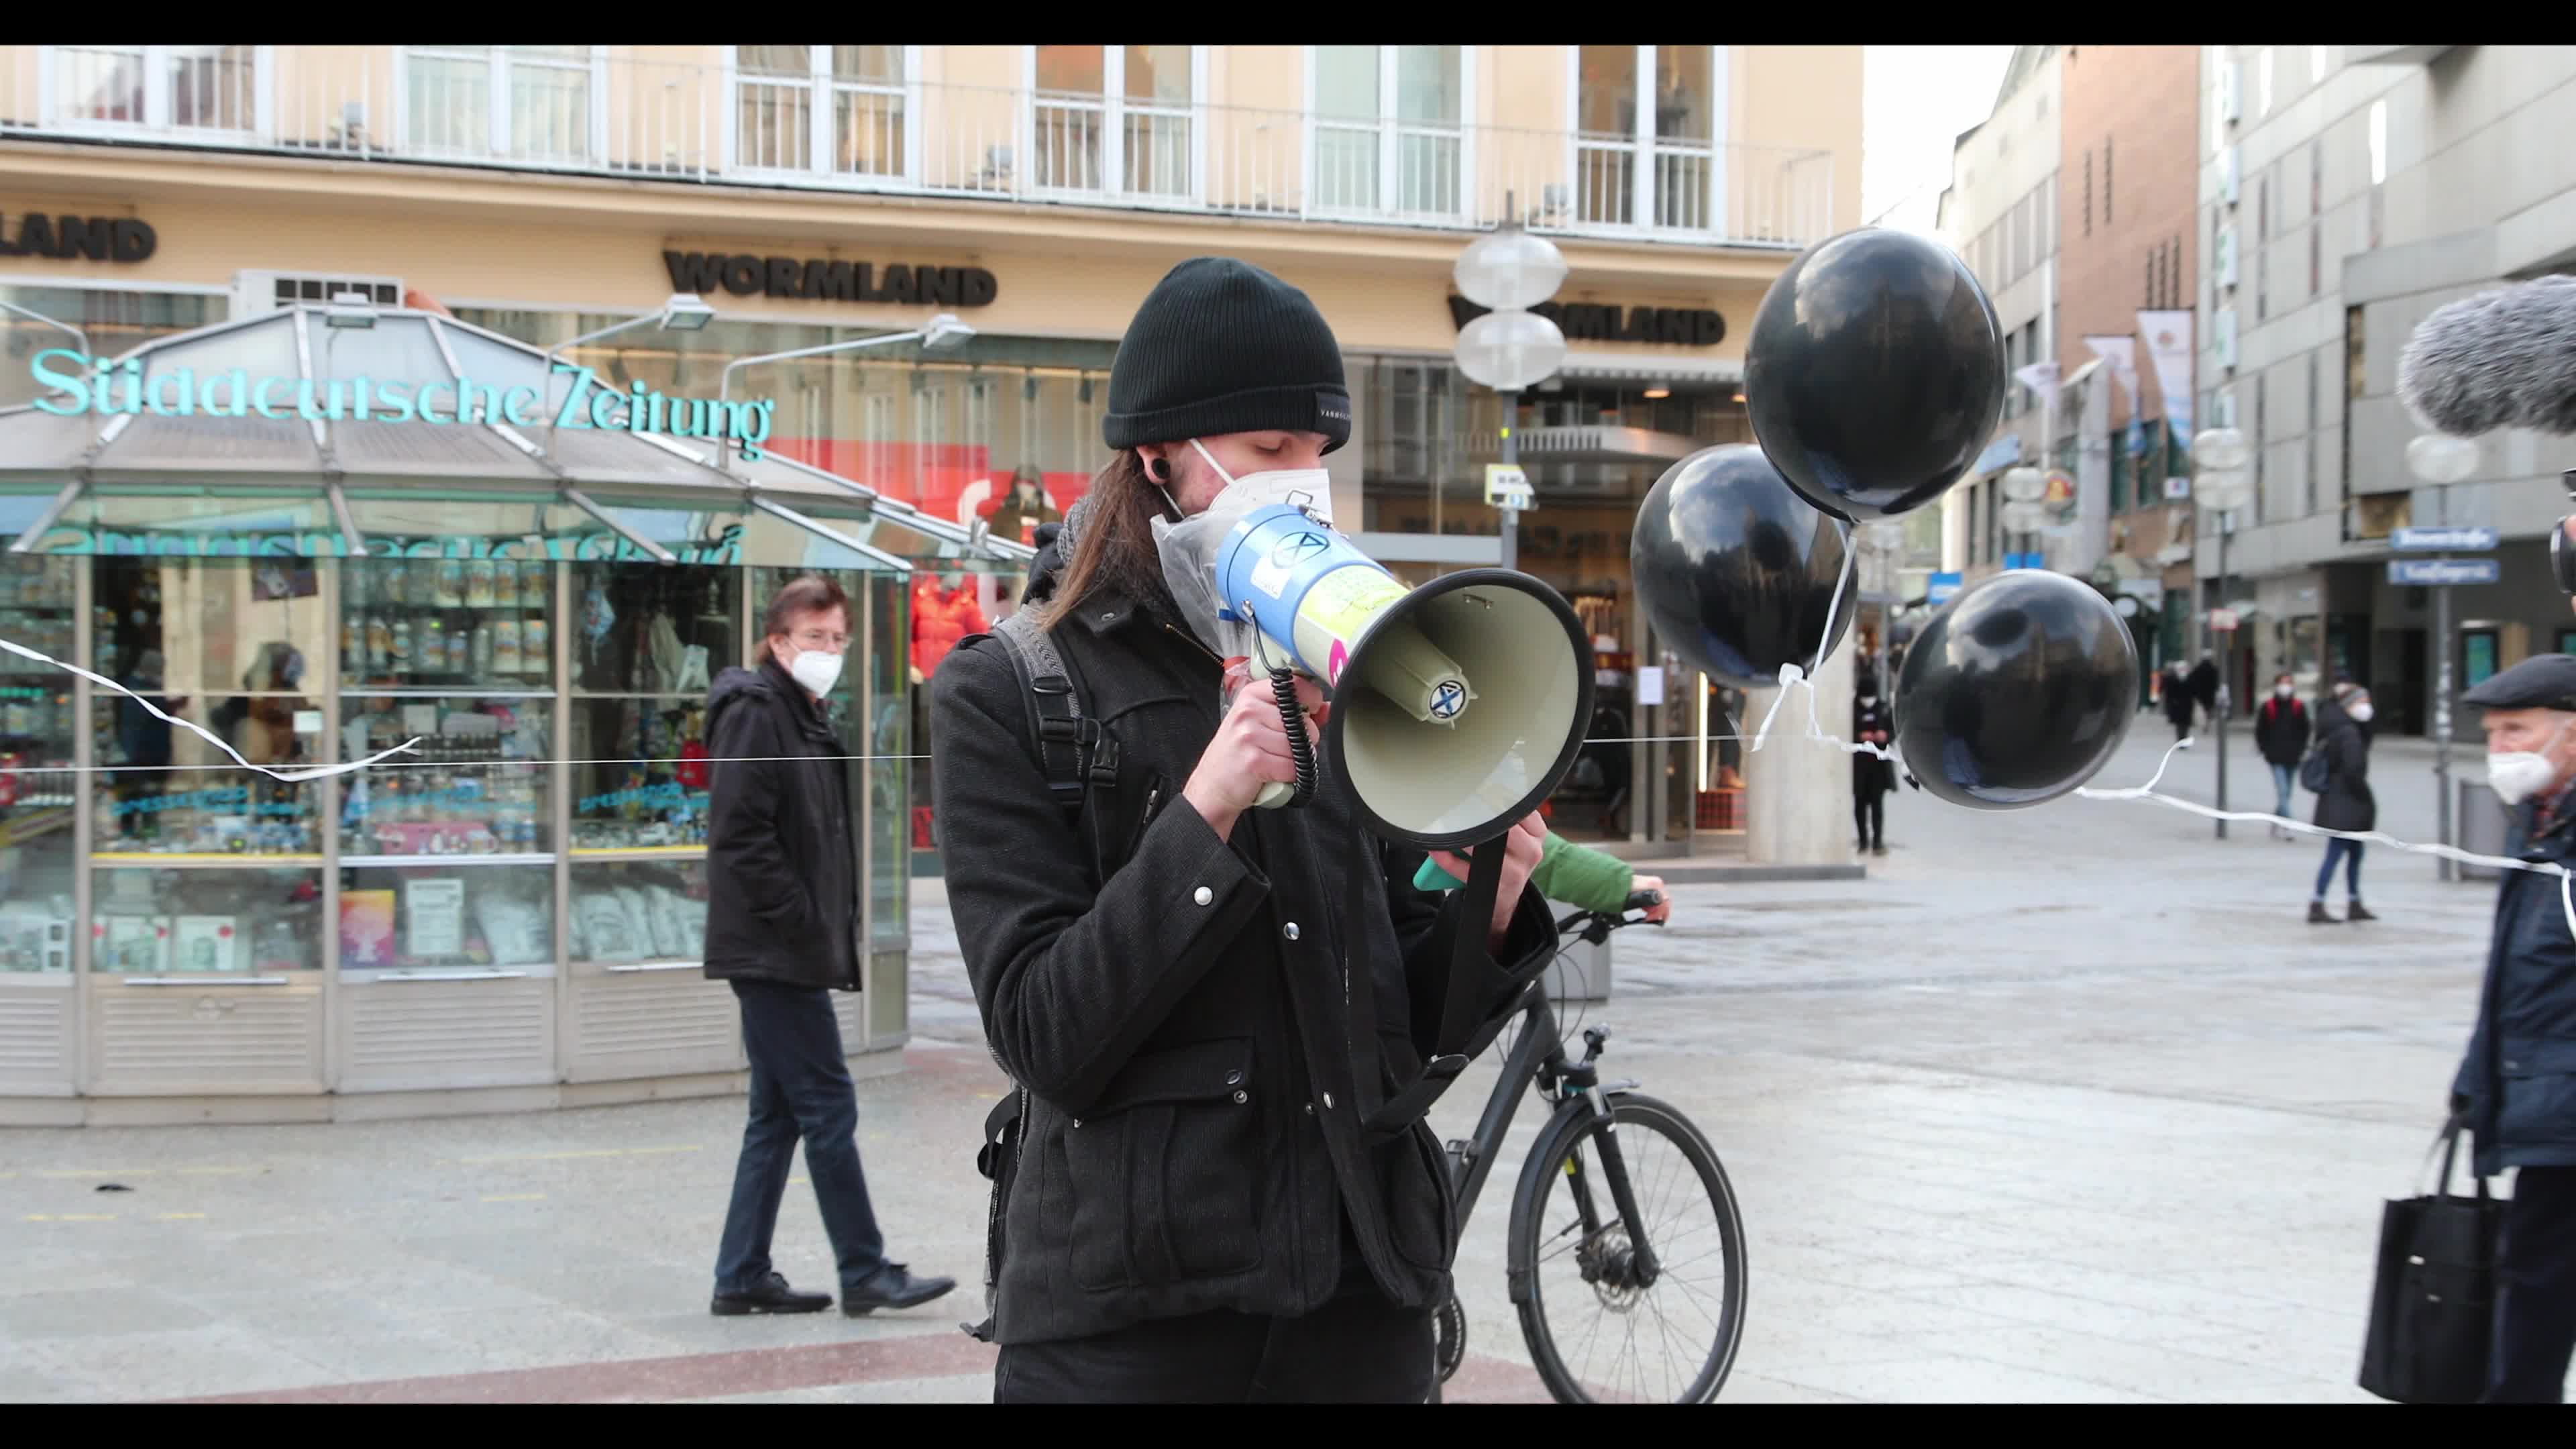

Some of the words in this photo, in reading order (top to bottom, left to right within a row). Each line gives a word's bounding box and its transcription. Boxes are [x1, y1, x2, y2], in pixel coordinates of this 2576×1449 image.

[663, 251, 997, 307] WORMLAND
[1448, 294, 1726, 346] MLAND
[31, 347, 543, 425] Süddeutsche
[551, 364, 775, 462] Zeitung
